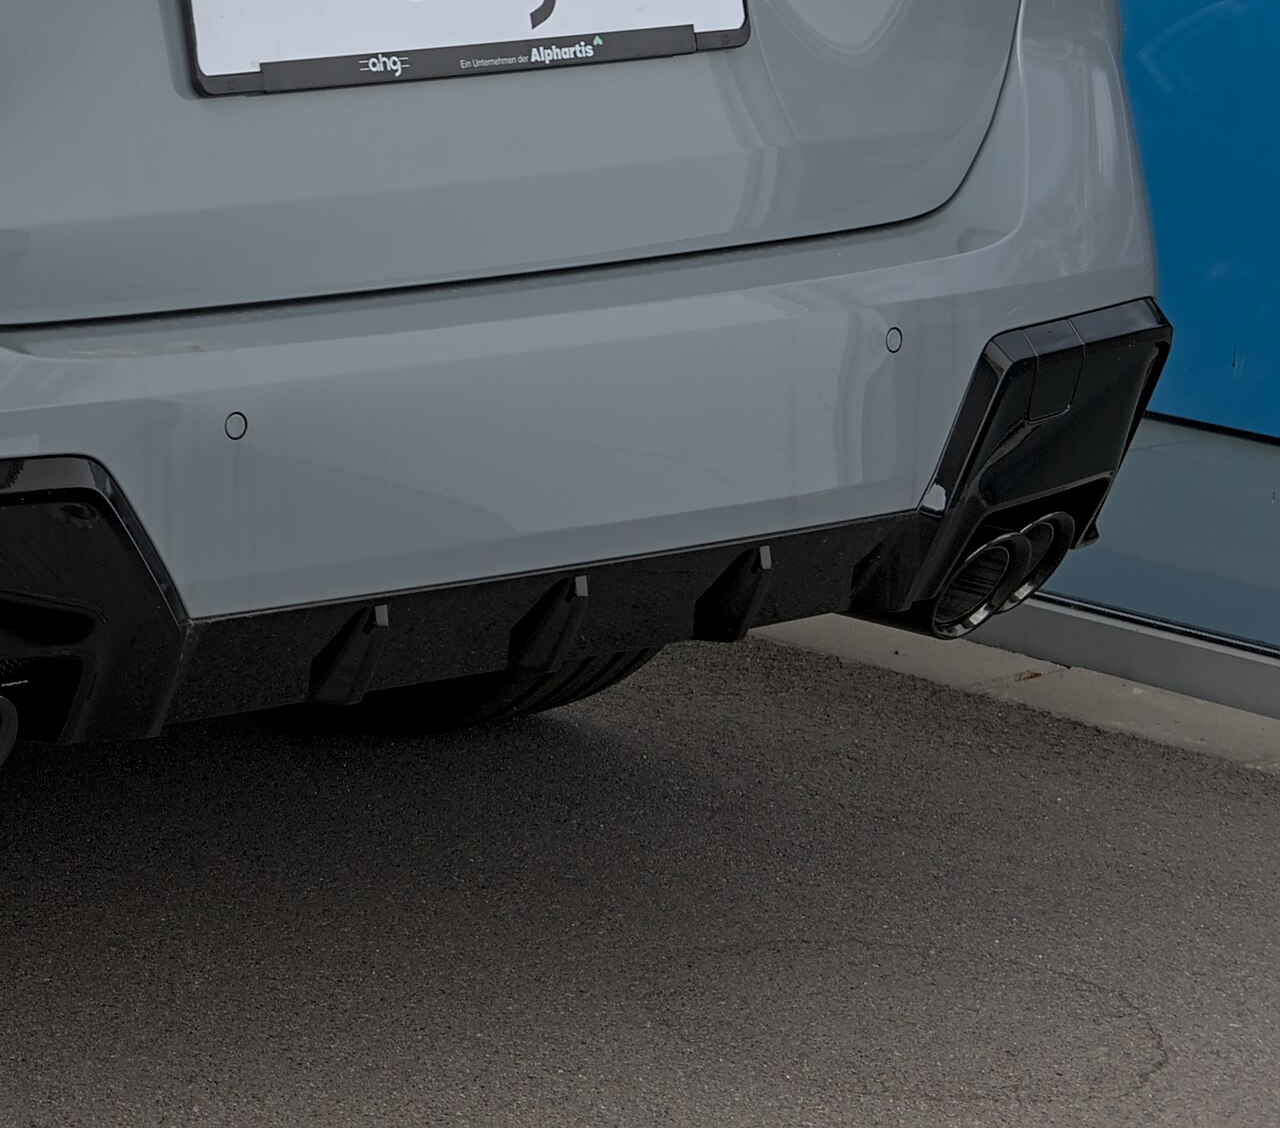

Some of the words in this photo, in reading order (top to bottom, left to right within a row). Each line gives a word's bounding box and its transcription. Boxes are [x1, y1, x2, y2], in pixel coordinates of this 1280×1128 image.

[368, 53, 402, 77] ahg
[460, 60, 472, 69] Ein
[472, 56, 517, 69] Unternehmen
[517, 54, 529, 64] der
[530, 42, 594, 64] Alphartis
